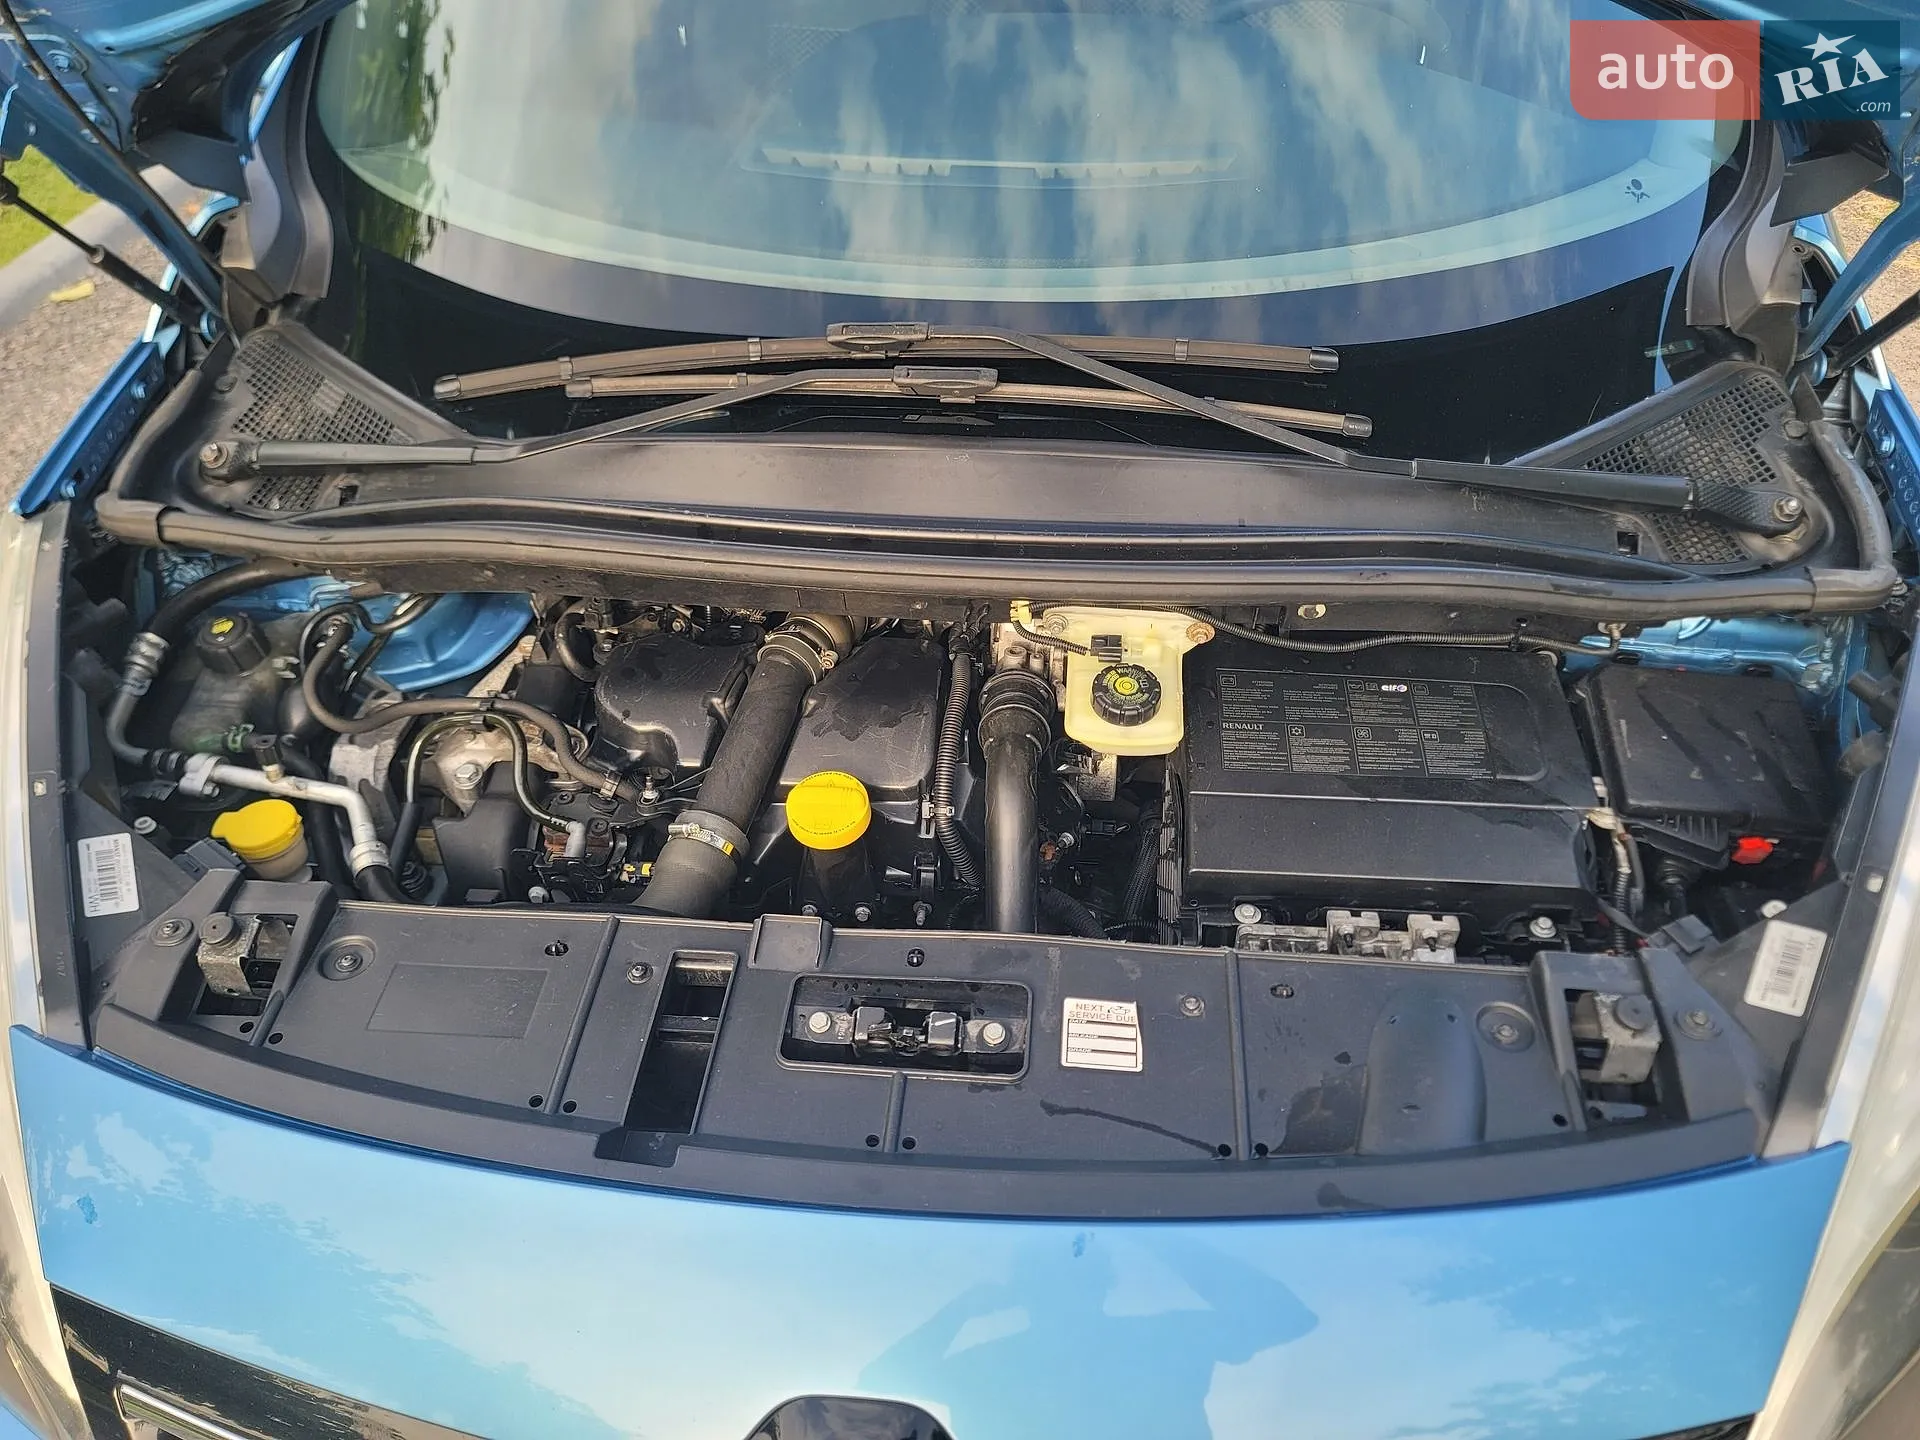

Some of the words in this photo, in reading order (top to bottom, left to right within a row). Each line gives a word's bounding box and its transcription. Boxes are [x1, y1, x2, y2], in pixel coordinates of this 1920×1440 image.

[1222, 722, 1264, 732] RENAULT
[1075, 1002, 1104, 1012] NEXT
[1069, 1010, 1113, 1021] SERVICE
[1116, 1014, 1137, 1023] DUE
